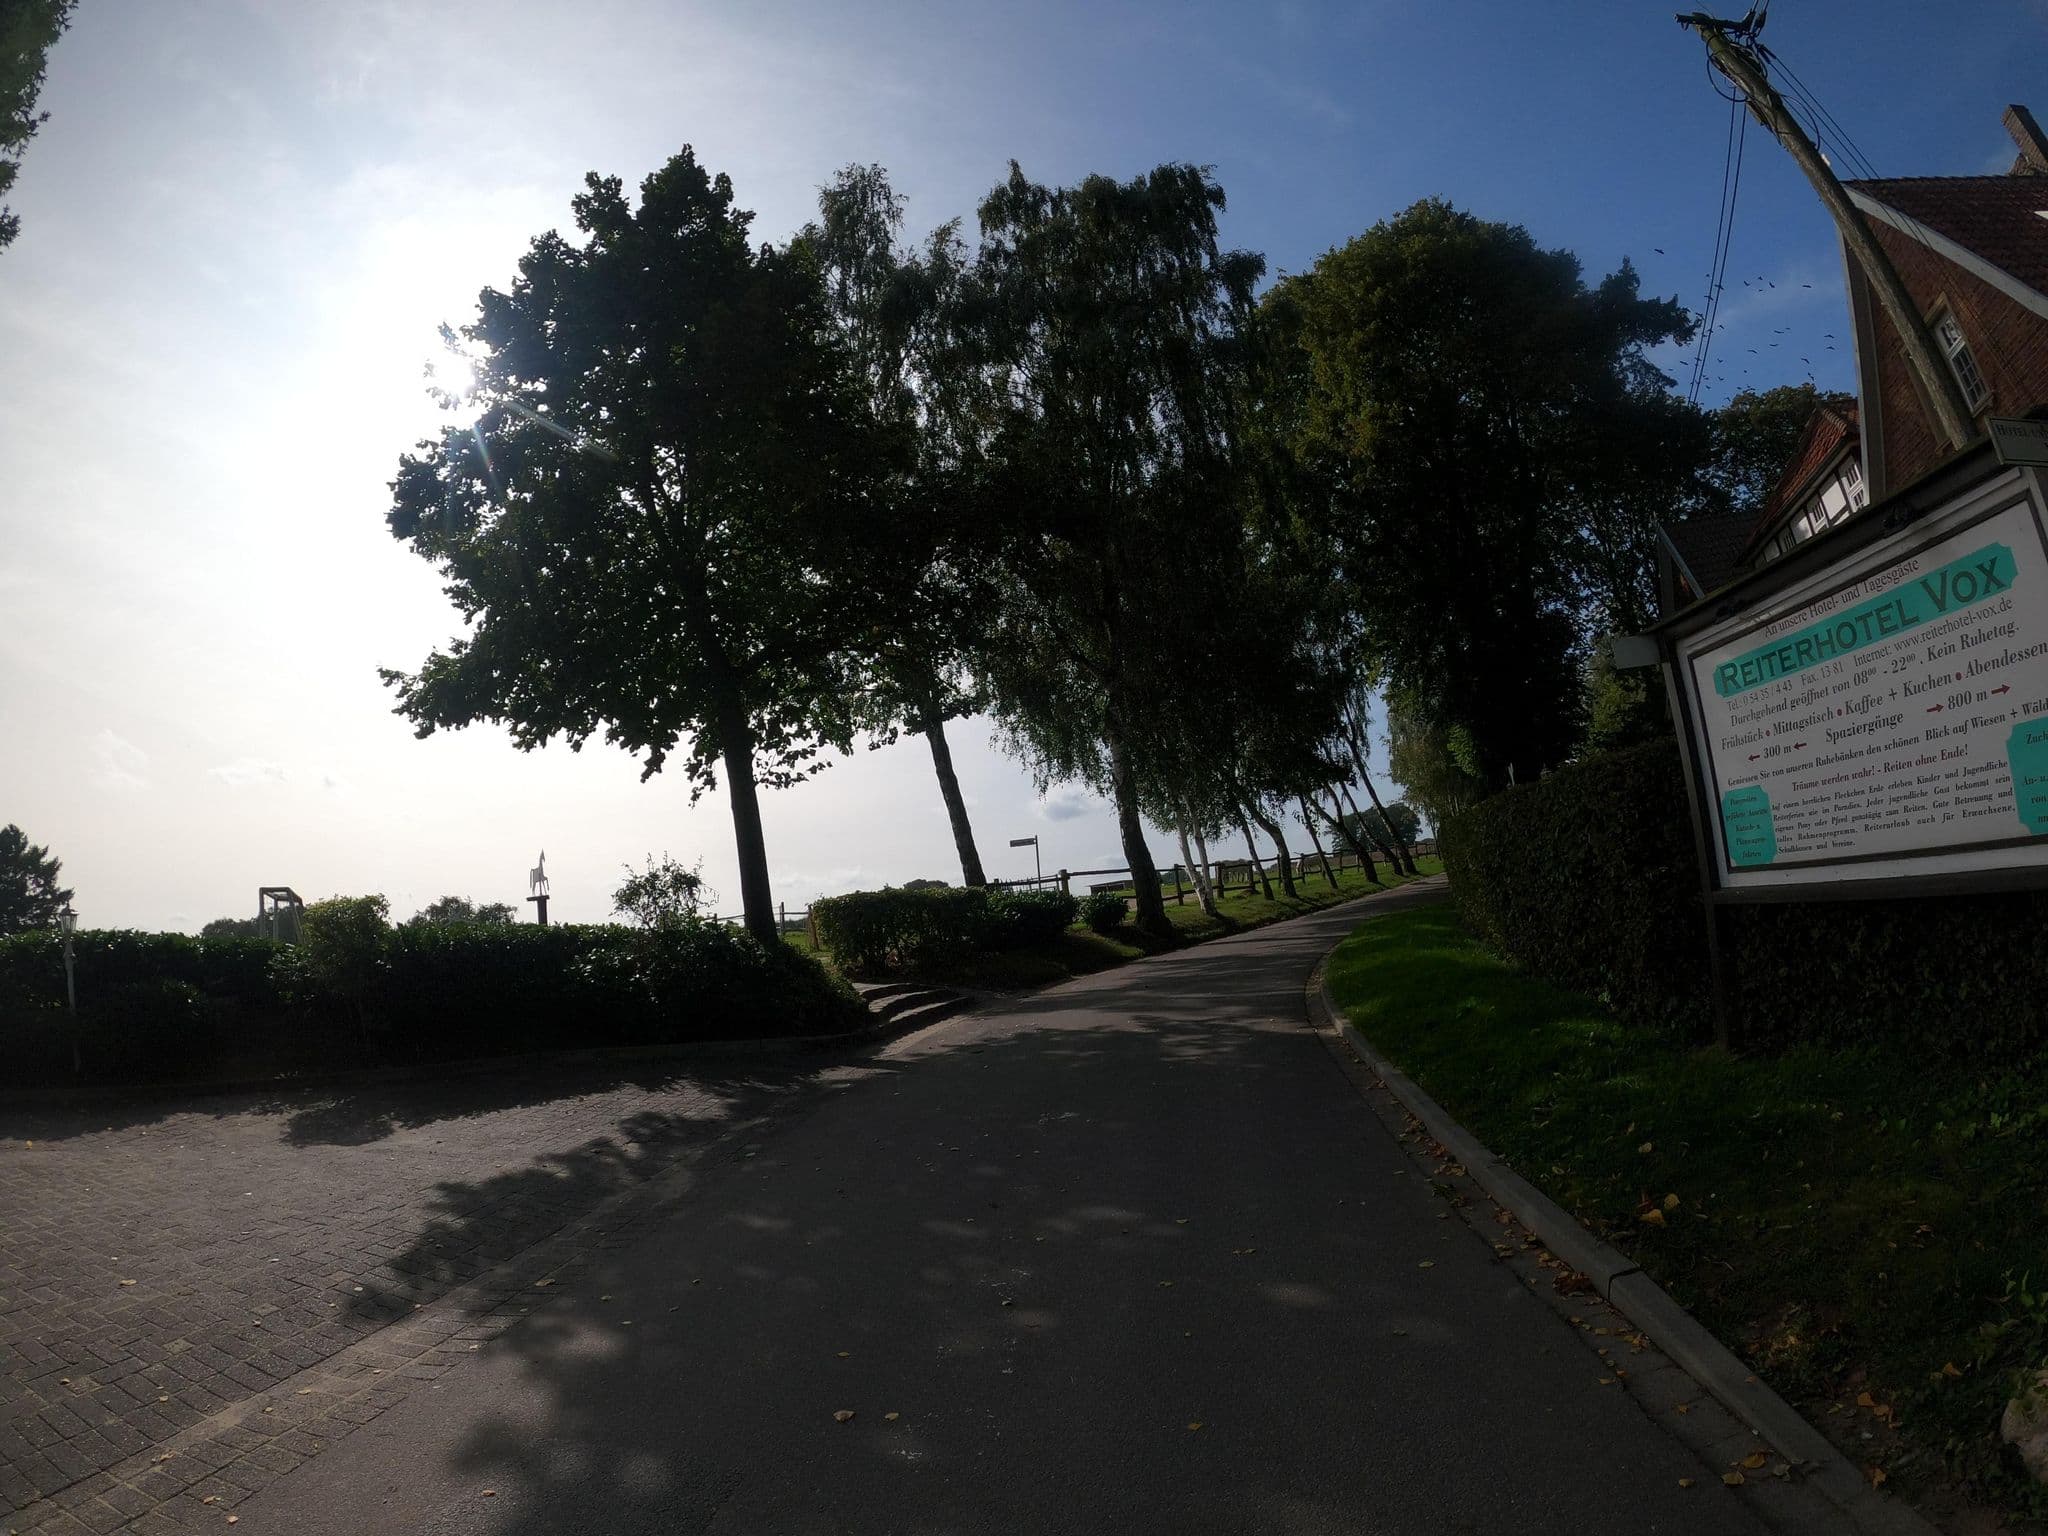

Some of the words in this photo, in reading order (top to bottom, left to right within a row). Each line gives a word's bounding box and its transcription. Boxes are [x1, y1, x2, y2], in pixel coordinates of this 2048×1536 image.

[1719, 598, 1920, 694] REITERHOTEL
[1920, 556, 2006, 613] VOX
[1764, 625, 1777, 638] An
[1779, 611, 1808, 631] unsere
[1808, 598, 1839, 618] Hotel-
[1841, 585, 1861, 603] und
[1863, 559, 1920, 593] Tagesgäste
[1731, 697, 1787, 727] Durchgehend
[1790, 686, 1829, 711] geöffnet
[1832, 680, 1850, 694] von
[1927, 642, 1957, 662] Kein
[1960, 621, 2020, 650] Ruhetag.
[1801, 673, 1819, 686] Fax.
[1854, 645, 1892, 666] Internet:
[1894, 597, 2013, 651] www.reiterhotel-vox.de
[1721, 728, 1764, 751] Frühstück
[1773, 706, 1834, 737] Mittagstisch
[1845, 694, 1883, 716] Kaffee
[1903, 673, 1952, 698] Kuchen
[1966, 641, 2048, 678] Abendessen
[1763, 744, 1781, 759] 300
[1783, 744, 1792, 754] m
[1825, 713, 1904, 744] Spaziergänge
[1947, 690, 1972, 710] 800
[1976, 690, 1988, 702] m
[1759, 770, 1770, 780] Sie
[1772, 768, 1785, 778] von
[1786, 761, 1814, 774] unseren
[1815, 748, 1864, 768] Ruhebänken
[1866, 744, 1882, 756] den
[1884, 736, 1920, 752] schönen
[1925, 725, 1950, 742] Blick
[1952, 720, 1968, 735] auf
[1970, 713, 2006, 729] Wiesen
[1792, 780, 1819, 792] Träume
[1822, 773, 1849, 786] werden
[1851, 765, 1875, 779] wahr!
[1883, 760, 1912, 773] Reiten
[1915, 754, 1938, 767] ohne
[1941, 743, 1968, 761] Ende!
[1834, 788, 1865, 800] Fleckchen
[1869, 784, 1884, 794] Erde
[1888, 779, 1913, 790] erleben
[1917, 773, 1941, 785] Kinder
[1944, 769, 1959, 779] und
[1962, 759, 2008, 777] Jugendliche
[1864, 818, 1911, 832] Reiterurlaub
[1916, 814, 1936, 825] auch
[1941, 811, 1955, 824] für
[1962, 803, 2016, 818] Erwachsene.
[1866, 797, 1884, 808] Jeder
[1889, 790, 1928, 805] jugendliche
[1934, 786, 1950, 796] Gast
[1955, 778, 1989, 791] bekommt
[1995, 775, 2011, 785] sein
[1933, 799, 1949, 809] Gute
[1954, 792, 1993, 806] Betreuung
[1997, 787, 2013, 799] und
